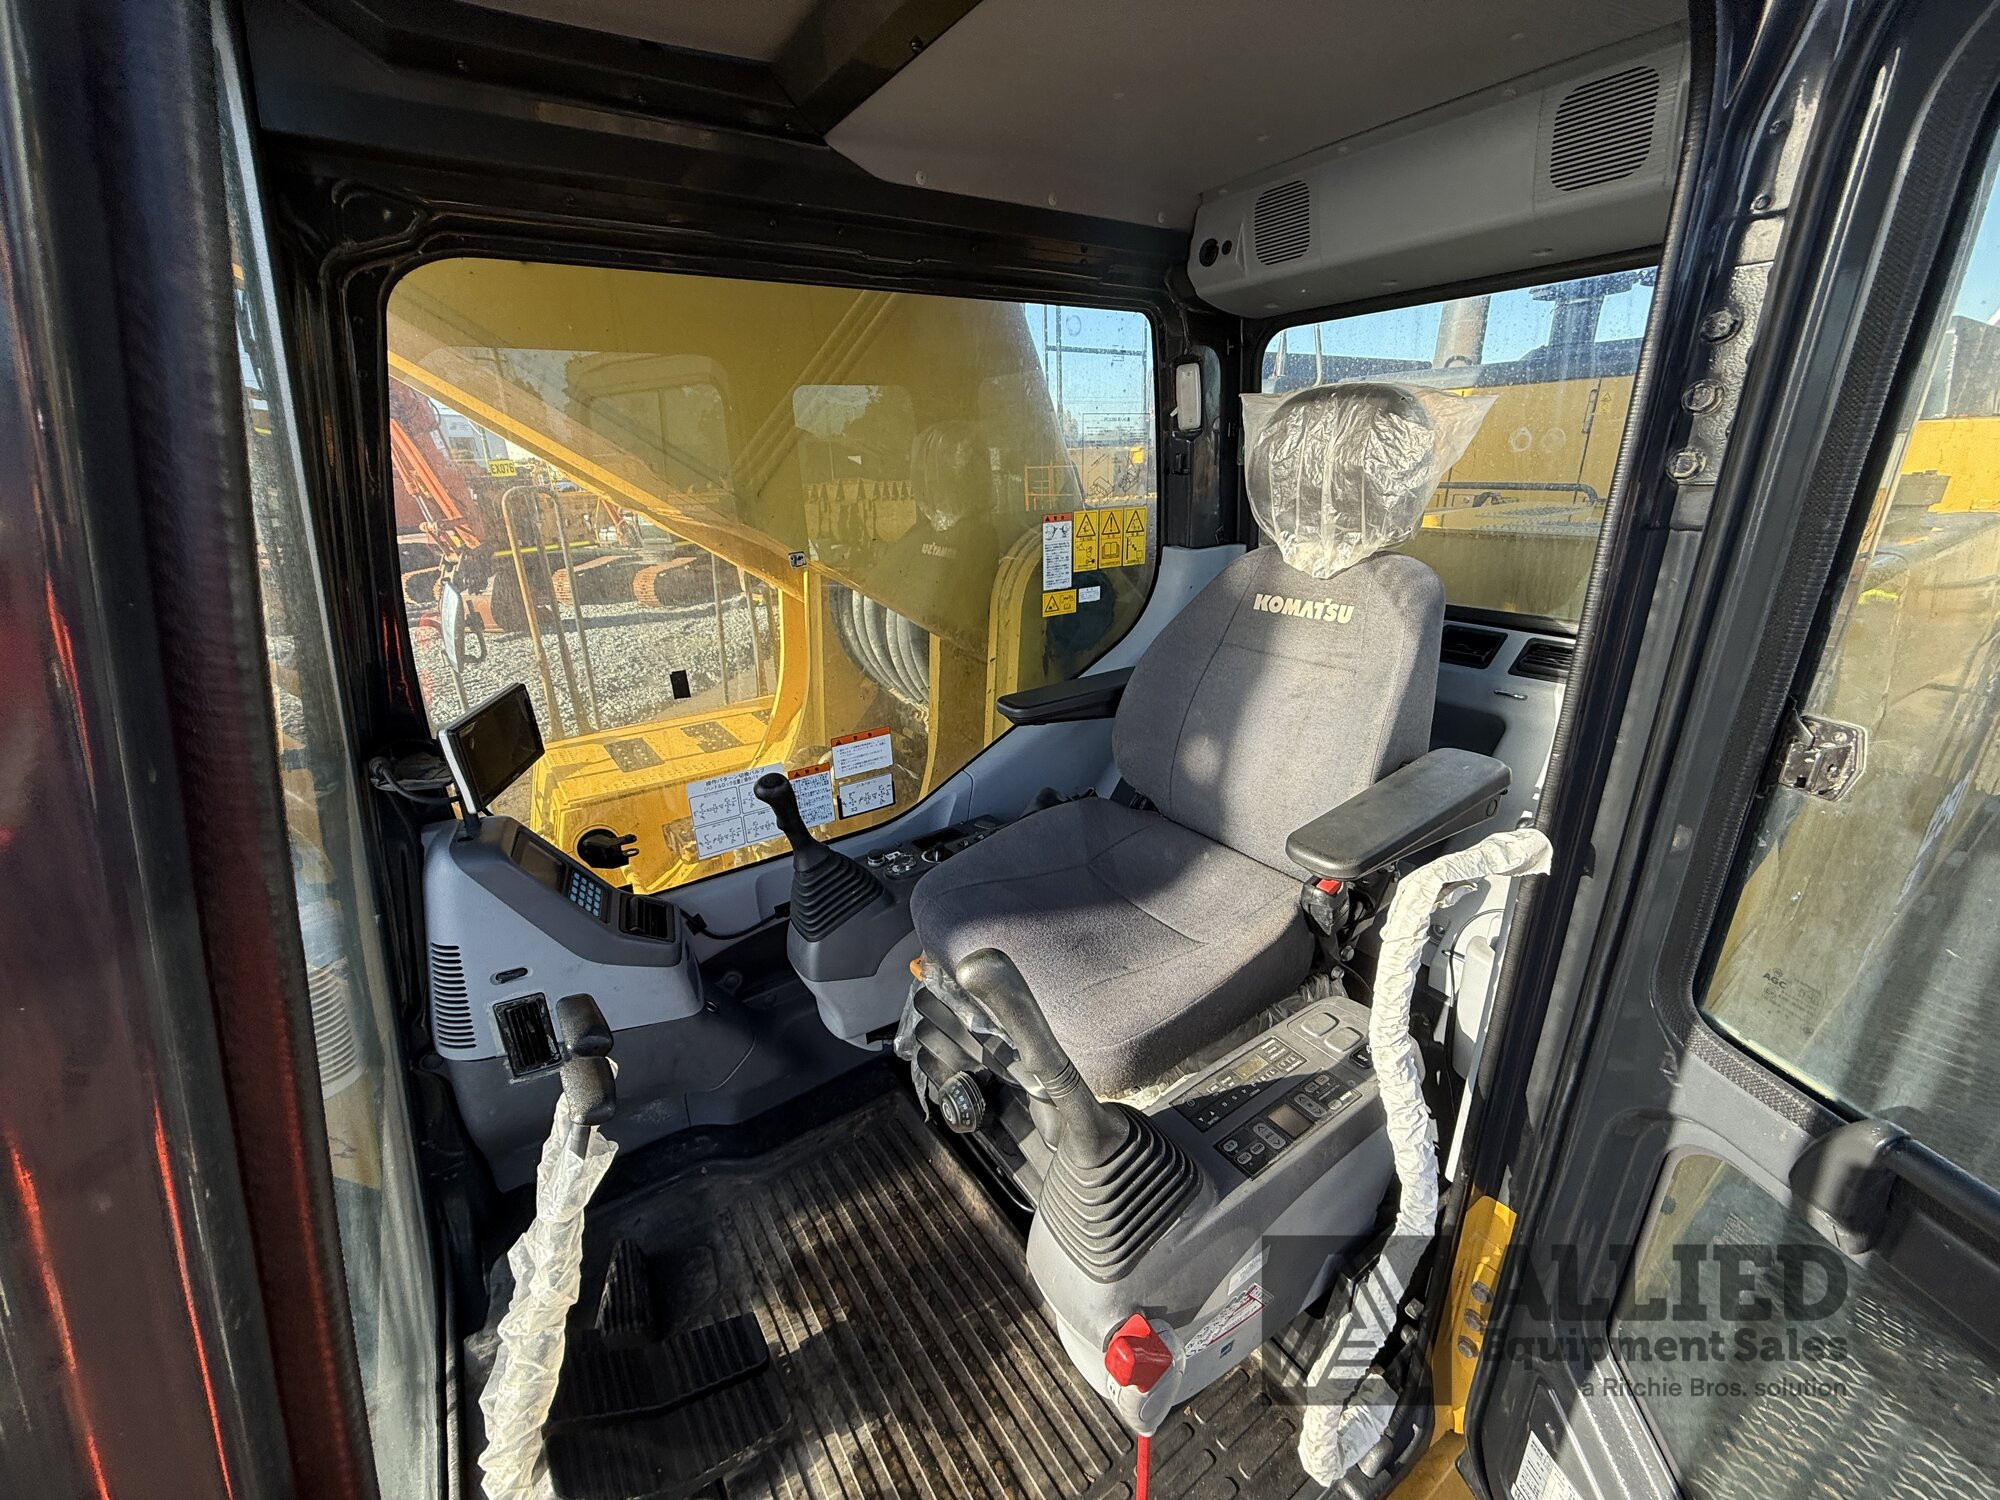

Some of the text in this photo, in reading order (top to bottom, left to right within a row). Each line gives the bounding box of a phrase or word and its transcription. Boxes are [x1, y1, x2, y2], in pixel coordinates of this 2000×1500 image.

[490, 462, 515, 474] EX076
[1253, 593, 1355, 624] KOMATSU
[1763, 972, 1787, 989] AGC
